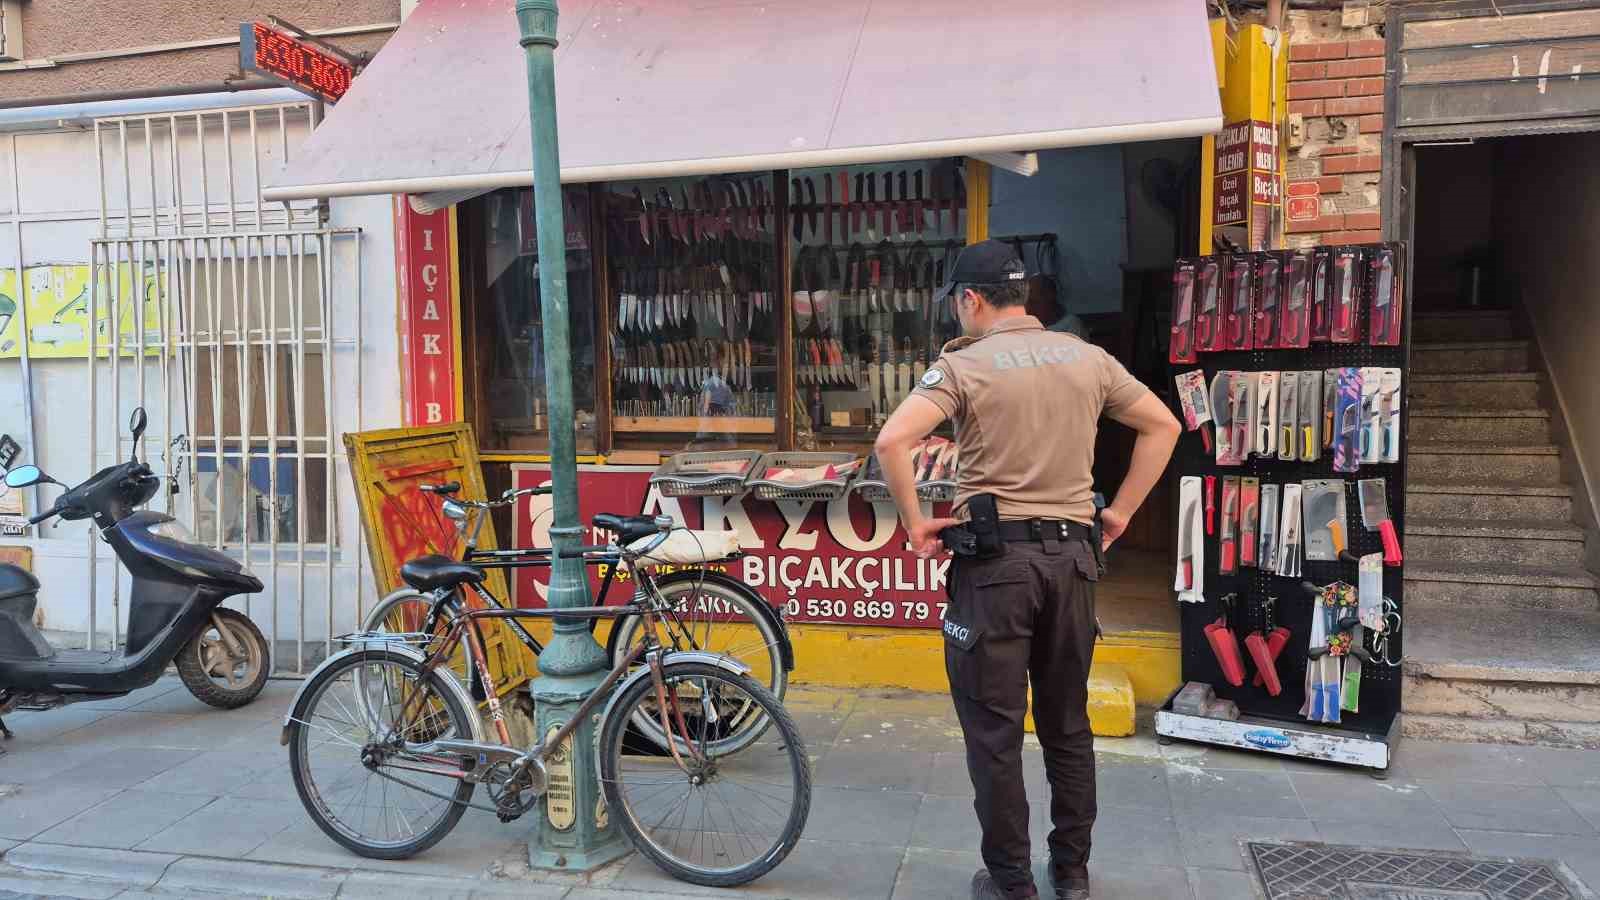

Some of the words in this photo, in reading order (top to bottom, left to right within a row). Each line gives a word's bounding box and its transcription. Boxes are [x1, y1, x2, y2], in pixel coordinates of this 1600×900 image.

[1222, 176, 1238, 190] Özel
[1220, 194, 1239, 208] Bıçak
[422, 229, 441, 355] IÇAK
[642, 482, 935, 553] AKYO
[743, 555, 950, 598] BIÇAKÇILIK
[788, 599, 800, 616] 0
[807, 600, 847, 617] 530
[853, 601, 895, 619] 869
[902, 602, 928, 620] 79
